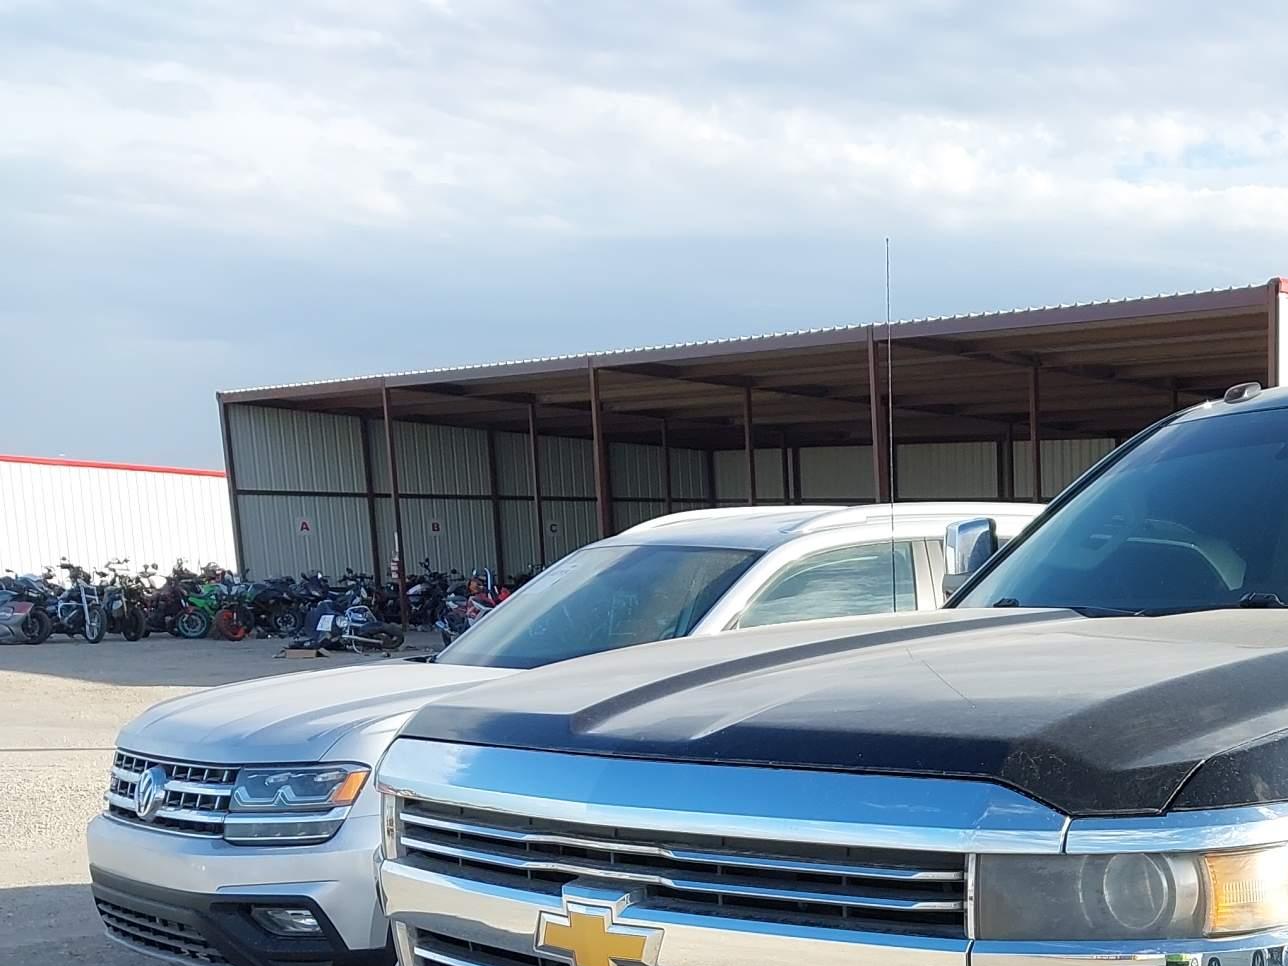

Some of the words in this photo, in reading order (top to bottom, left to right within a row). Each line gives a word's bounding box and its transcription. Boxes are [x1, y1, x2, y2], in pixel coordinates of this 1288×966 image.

[300, 521, 310, 532] A
[431, 522, 441, 532] B
[550, 523, 558, 533] C
